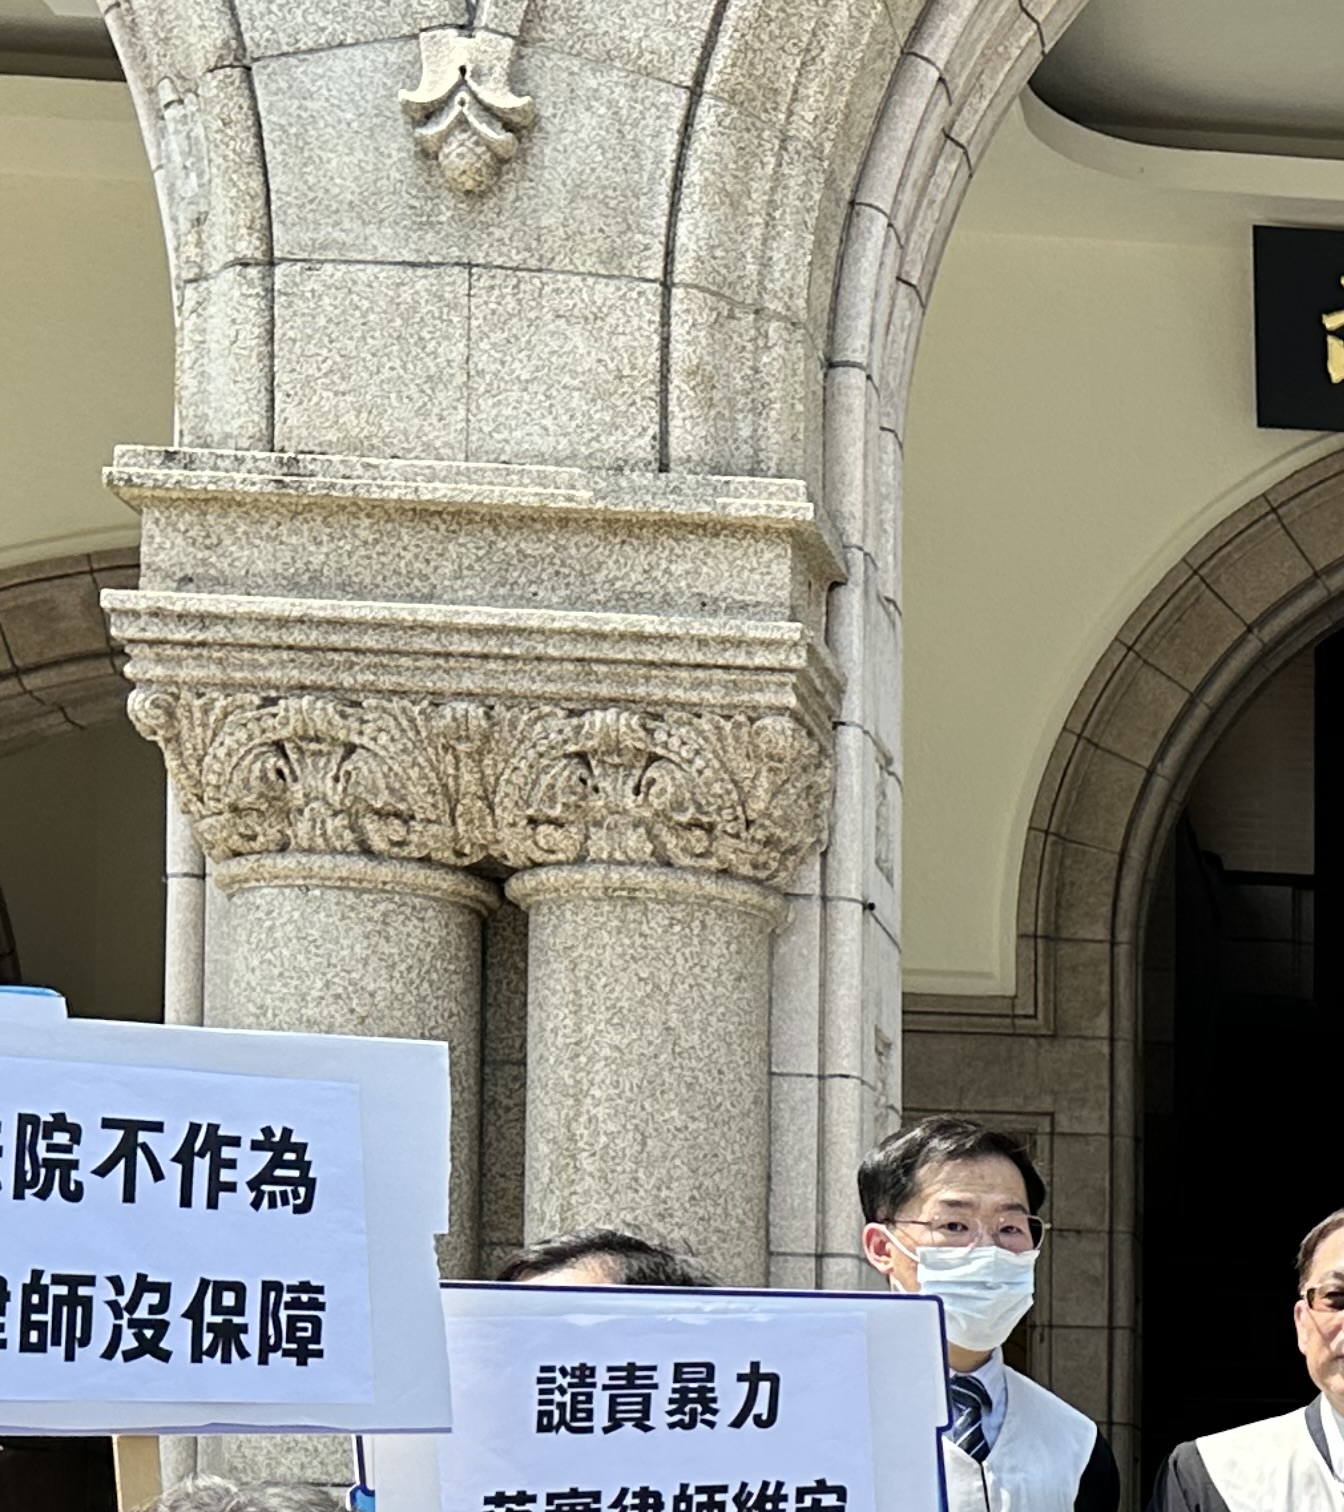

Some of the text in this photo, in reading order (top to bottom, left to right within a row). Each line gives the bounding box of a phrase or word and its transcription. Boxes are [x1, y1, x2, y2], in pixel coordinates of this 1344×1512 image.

[0, 1112, 318, 1215] 院不作為
[0, 1268, 327, 1367] 師沒保障
[535, 1360, 781, 1435] 譴責暴力
